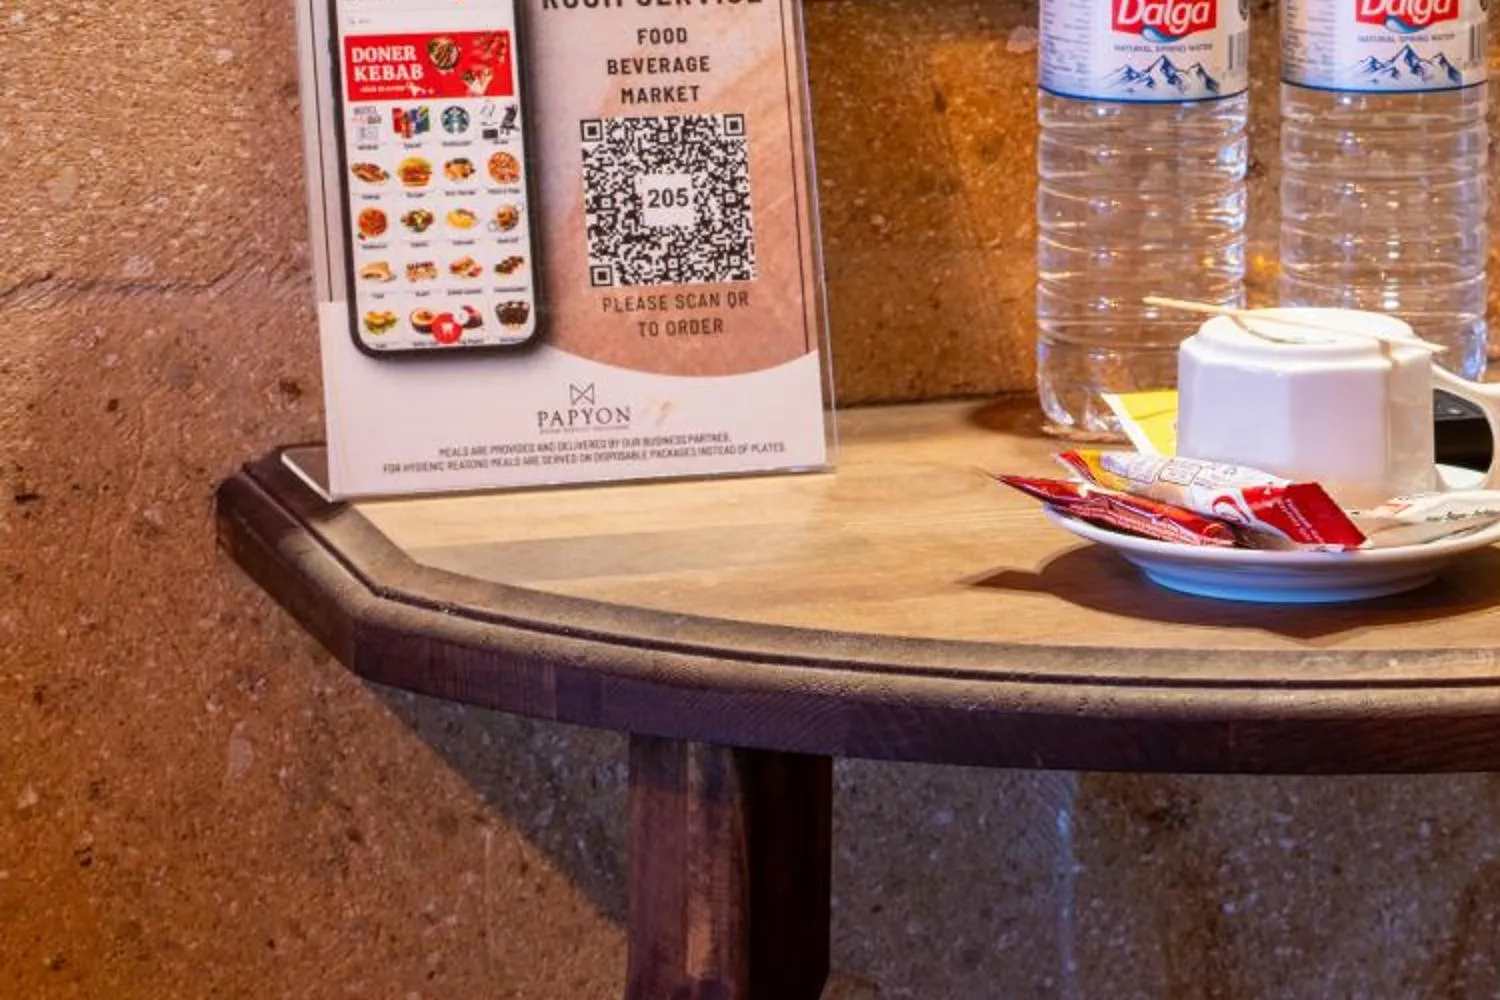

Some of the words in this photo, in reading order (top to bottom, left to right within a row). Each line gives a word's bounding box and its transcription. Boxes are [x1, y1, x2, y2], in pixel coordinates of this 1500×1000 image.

[637, 27, 688, 45] FOOD
[351, 45, 417, 63] DONER
[353, 63, 425, 82] KEBAB
[607, 56, 711, 75] BEVERAGE
[621, 85, 700, 104] MARKET
[647, 188, 689, 209] 205
[602, 294, 669, 313] PLEASE
[675, 292, 720, 310] SCAN
[637, 321, 659, 337] TO
[665, 317, 724, 337] ORDER
[538, 407, 632, 427] PAPYON
